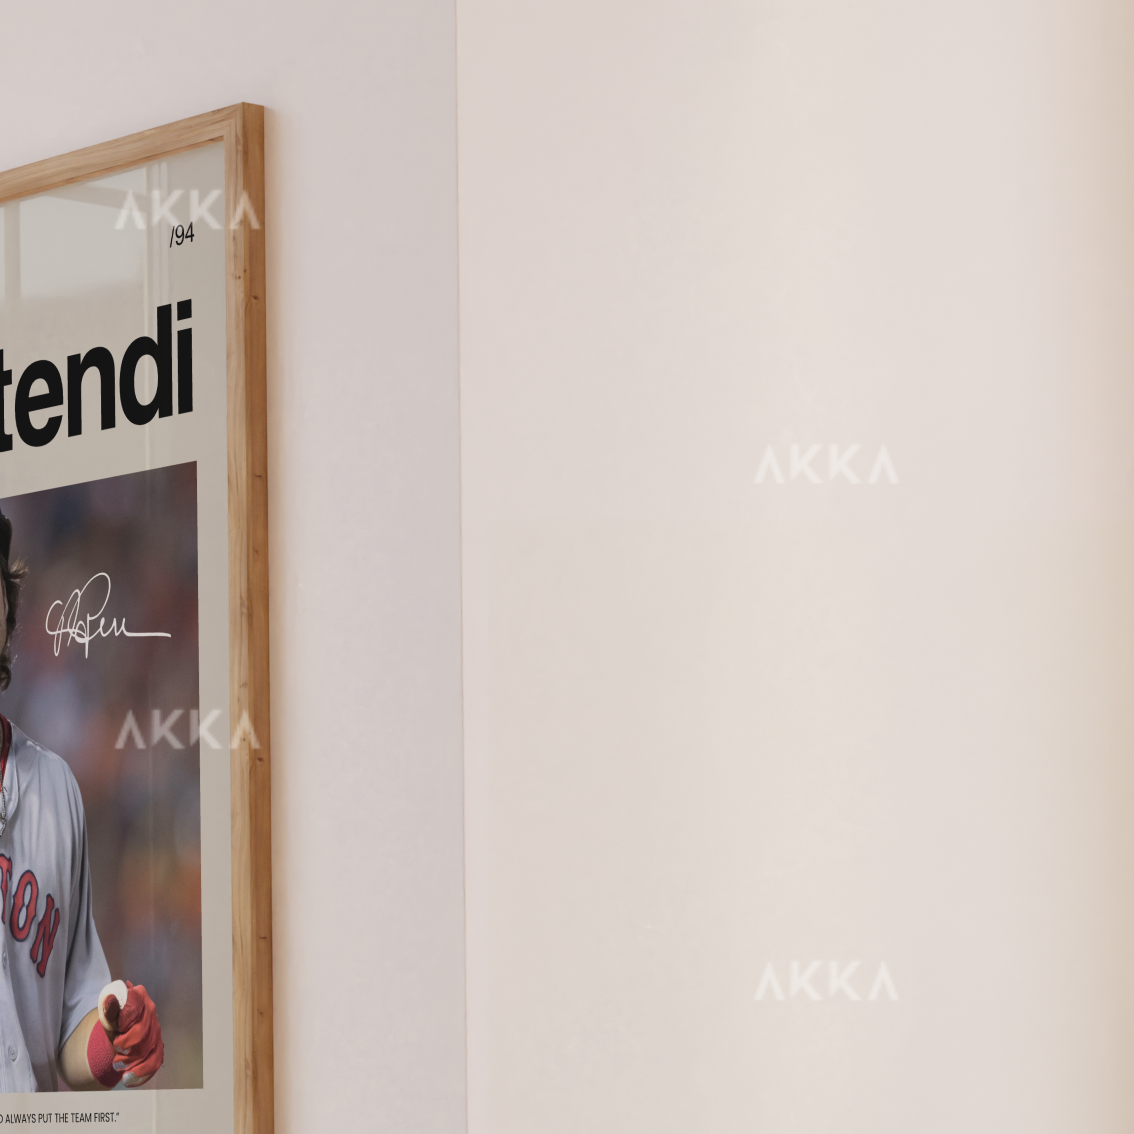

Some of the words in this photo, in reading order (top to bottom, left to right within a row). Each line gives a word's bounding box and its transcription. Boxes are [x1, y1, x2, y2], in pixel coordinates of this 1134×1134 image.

[169, 222, 195, 248] /94
[5, 1113, 37, 1124] ALWAYS
[37, 1112, 52, 1123] PUT
[54, 1112, 69, 1123] THE
[70, 1112, 92, 1123] TEAM
